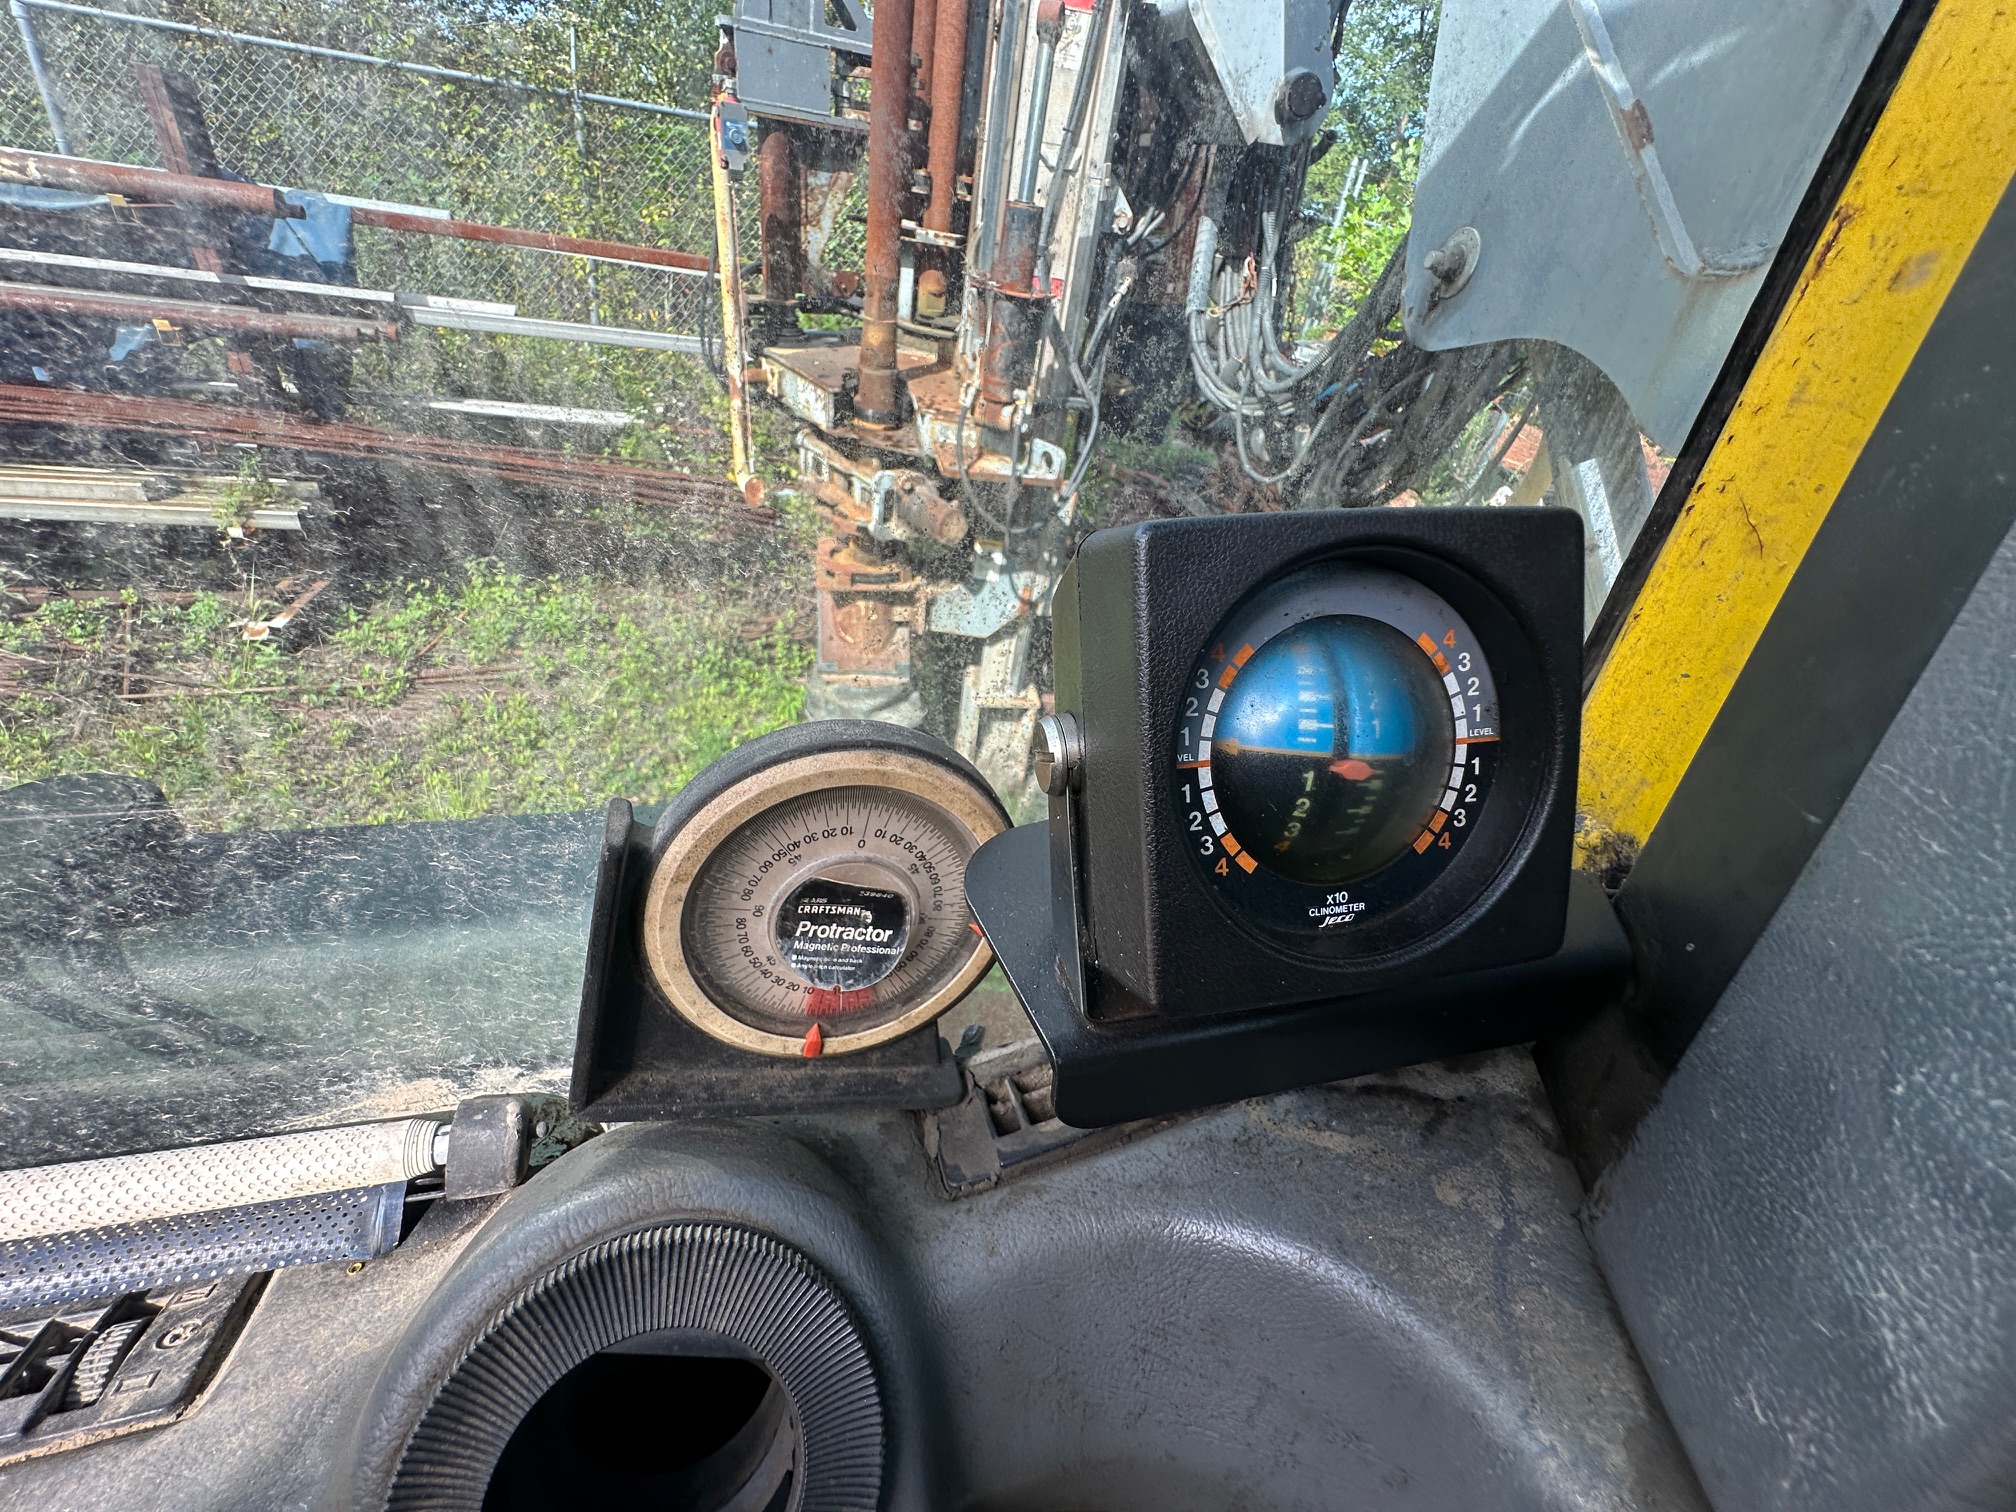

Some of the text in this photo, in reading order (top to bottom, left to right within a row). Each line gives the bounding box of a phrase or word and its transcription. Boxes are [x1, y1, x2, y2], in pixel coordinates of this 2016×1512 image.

[1442, 629, 1457, 649] 4
[1211, 643, 1226, 662] 4
[1458, 652, 1471, 672] 3
[1195, 668, 1210, 689] 3
[1467, 677, 1480, 696] 2
[1185, 696, 1199, 717] 2
[1472, 703, 1481, 722] 1
[1180, 726, 1190, 746] 1
[1469, 727, 1494, 737] LEVEL
[1177, 753, 1194, 762] VEL
[1471, 757, 1480, 775] 1
[1302, 770, 1315, 791] 1
[1181, 784, 1191, 803] 1
[1464, 783, 1477, 803] 2
[1292, 797, 1310, 817] 2
[1189, 811, 1203, 831] 2
[1453, 808, 1467, 828] 3
[1200, 835, 1214, 856] 3
[1438, 831, 1452, 850] 4
[1214, 857, 1229, 876] 4
[797, 905, 861, 916] CRAFTSMAN
[1309, 902, 1366, 917] CLINOMETER
[736, 917, 747, 930] 80
[795, 920, 893, 942] Protractor
[924, 926, 936, 938] 80
[737, 931, 749, 944] 70
[917, 939, 928, 950] 70
[741, 945, 754, 957] 60
[793, 940, 900, 956] Magnetic Professional
[749, 956, 763, 969] 50
[760, 968, 773, 979] 40
[771, 975, 786, 986] 30
[785, 982, 800, 991] 20
[803, 986, 815, 995] 10
